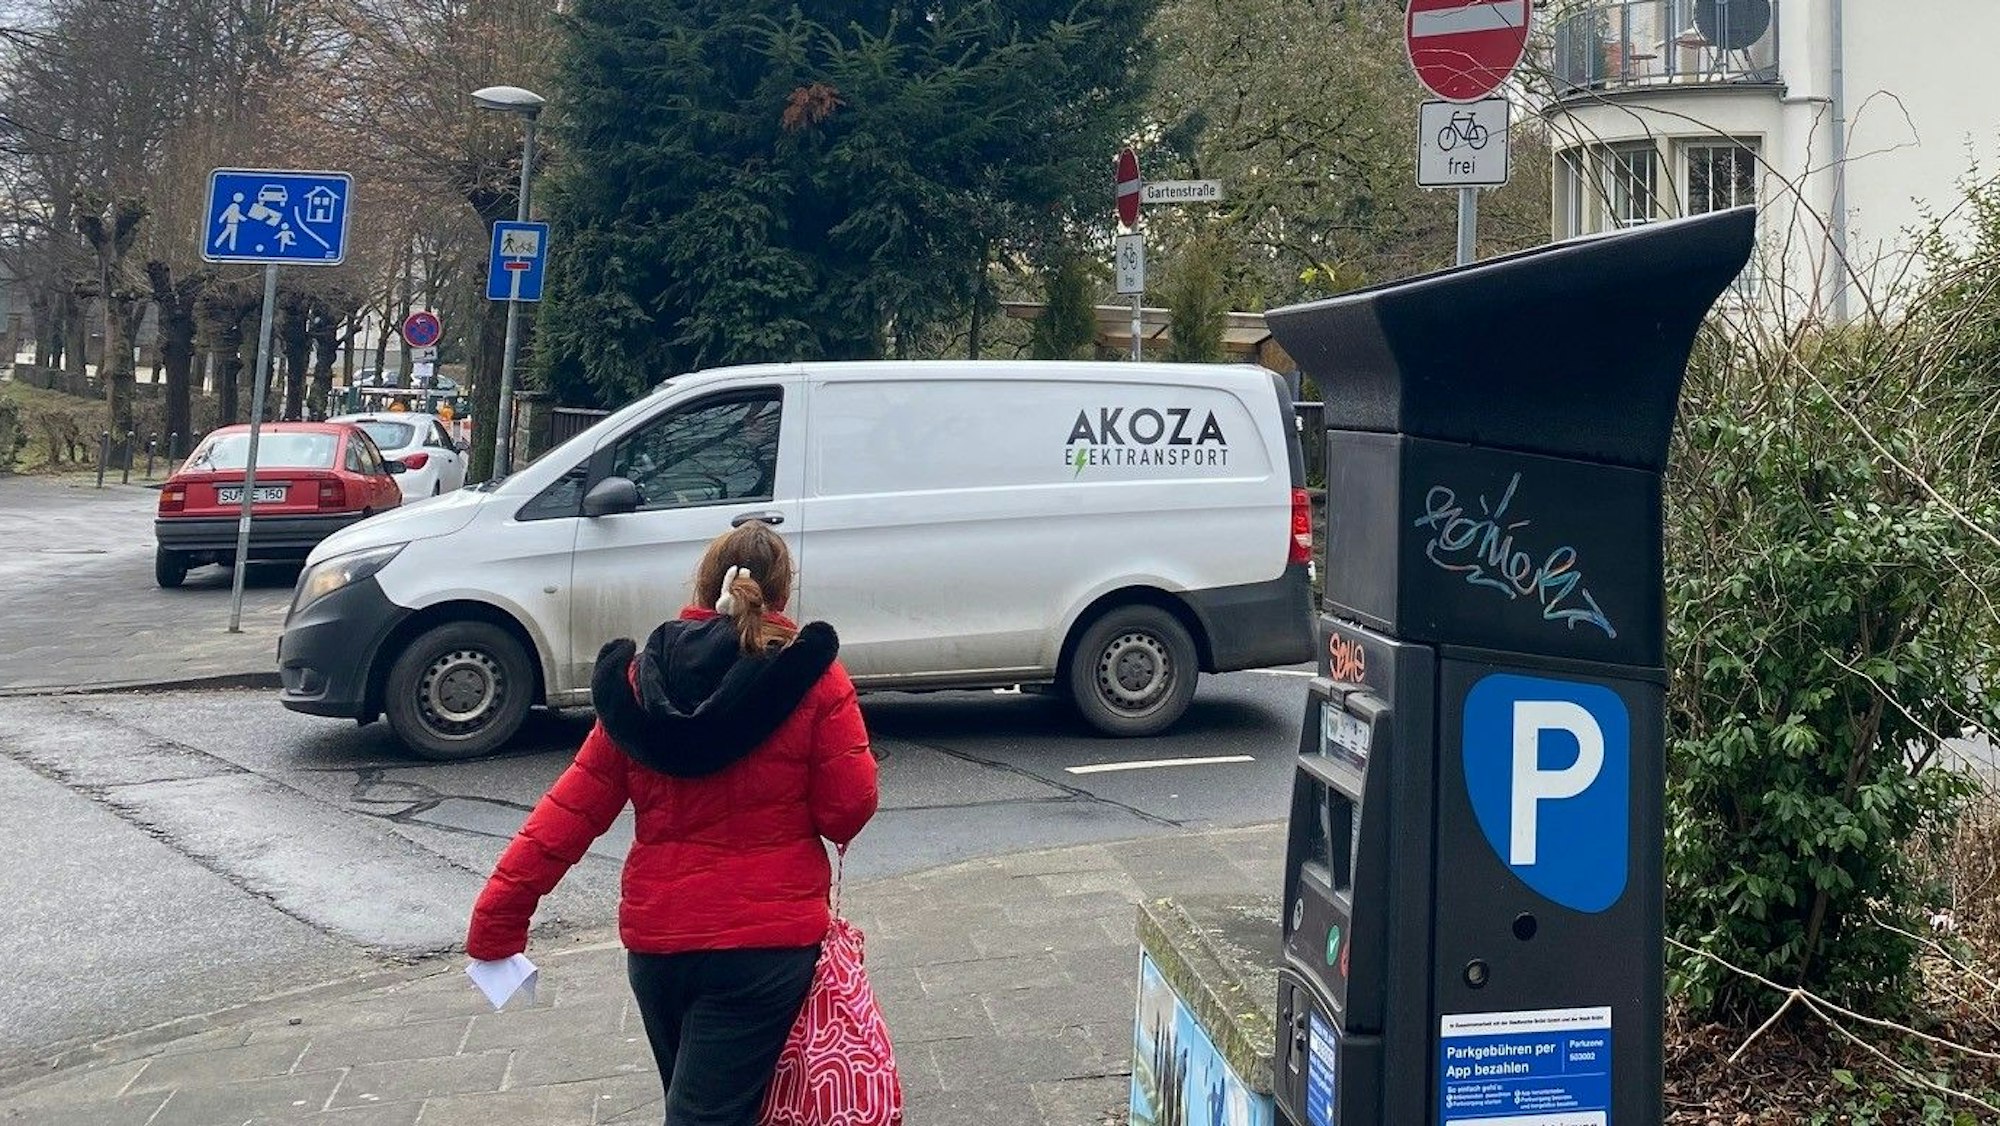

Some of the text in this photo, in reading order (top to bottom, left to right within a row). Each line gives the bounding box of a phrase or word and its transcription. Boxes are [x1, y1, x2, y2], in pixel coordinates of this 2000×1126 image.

[1448, 156, 1476, 175] frei
[1147, 183, 1216, 199] Gartenstraße
[1066, 407, 1227, 445] AKOZA
[221, 490, 238, 501] SU
[1510, 700, 1605, 865] P
[1447, 1042, 1557, 1060] Parkgebühren per
[1569, 1039, 1604, 1049] Parkzone
[1446, 1062, 1530, 1079] App bezahlen
